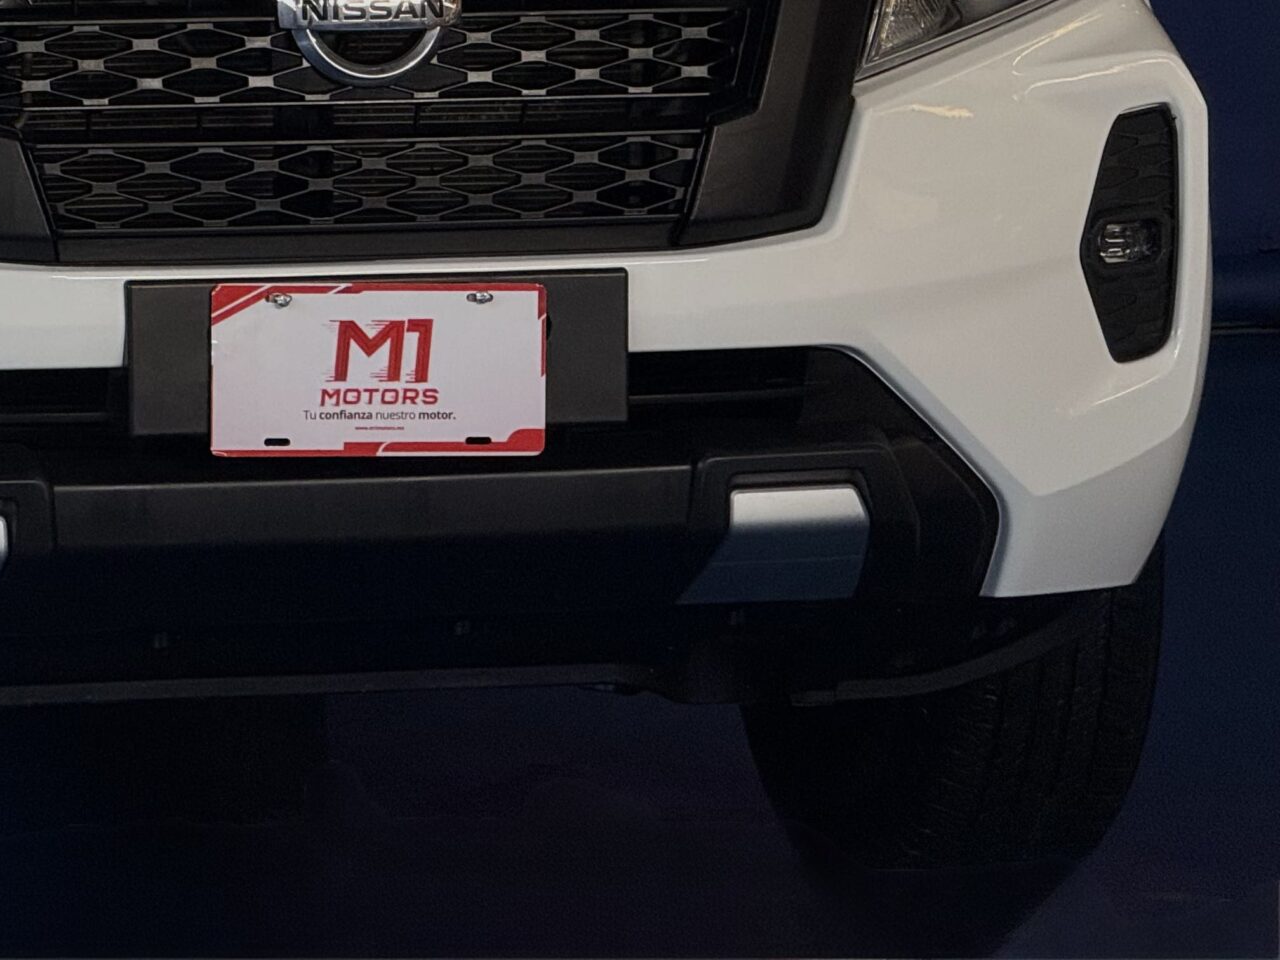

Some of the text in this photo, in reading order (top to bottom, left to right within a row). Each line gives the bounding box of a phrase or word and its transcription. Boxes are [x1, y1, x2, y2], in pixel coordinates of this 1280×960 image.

[324, 318, 434, 383] M1
[320, 388, 440, 407] MOTORS
[303, 410, 457, 420] Tu confianza nuestro motor.
